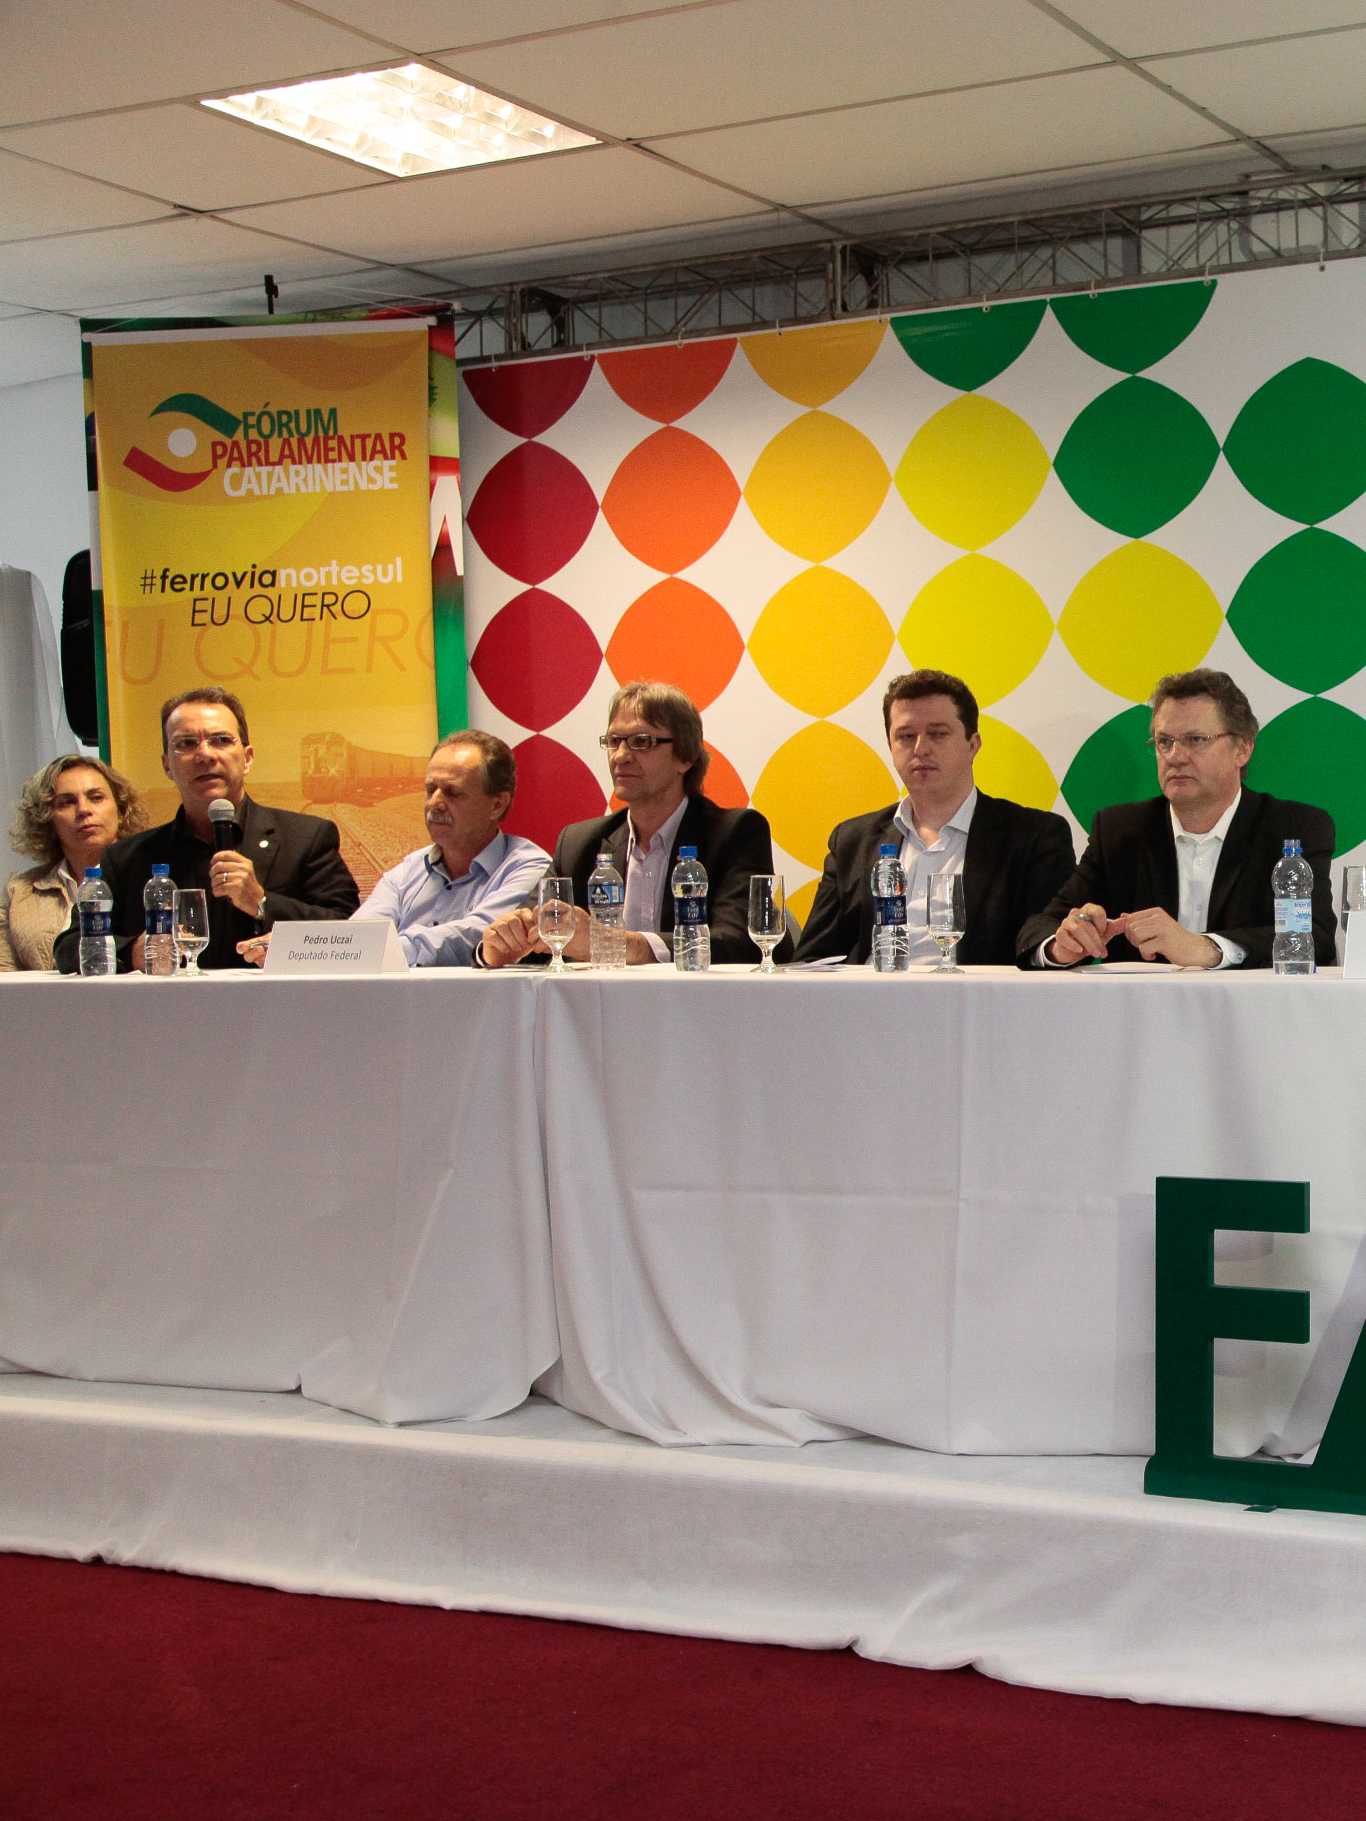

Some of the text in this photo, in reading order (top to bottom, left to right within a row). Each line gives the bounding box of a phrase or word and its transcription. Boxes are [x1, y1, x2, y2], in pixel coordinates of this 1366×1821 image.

[243, 402, 338, 440] FÓRUM
[211, 432, 407, 469] PARLAMENTAR
[223, 460, 398, 497] CATARINENSE
[140, 557, 403, 594] #ferrovianortesul
[191, 590, 371, 627] EU QUERO
[288, 951, 361, 961] Deputado Federal
[303, 935, 353, 944] Pedro Uczai
